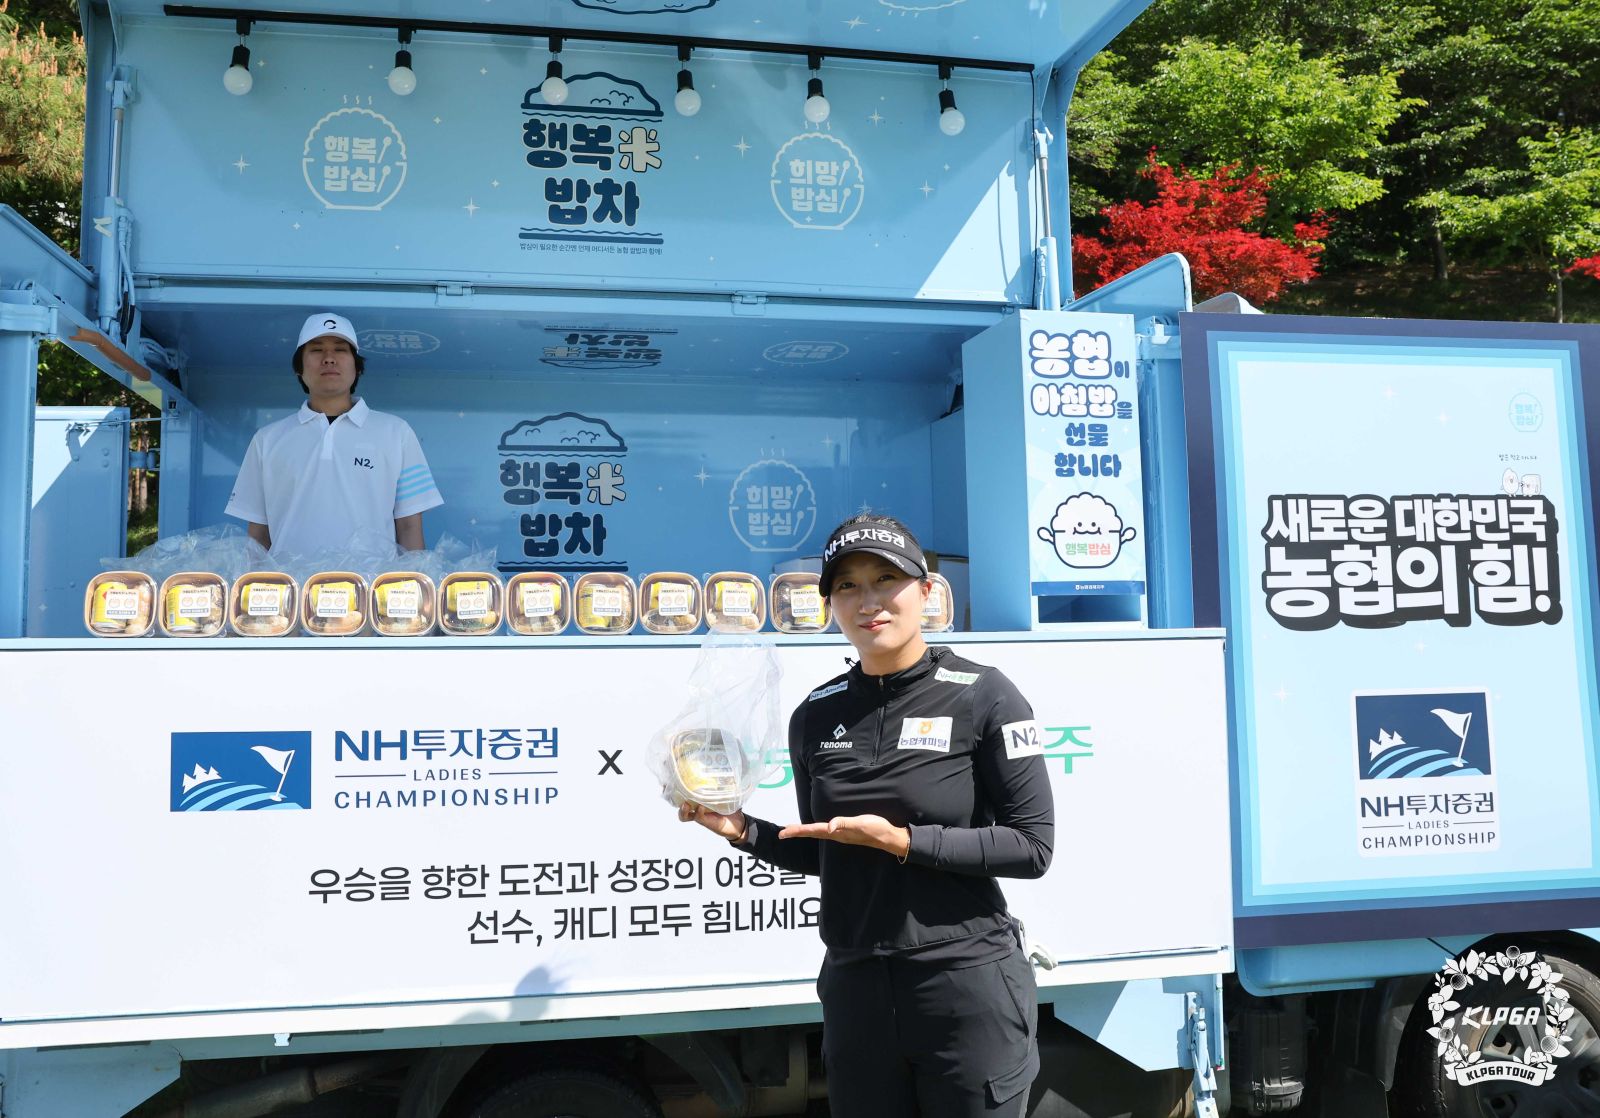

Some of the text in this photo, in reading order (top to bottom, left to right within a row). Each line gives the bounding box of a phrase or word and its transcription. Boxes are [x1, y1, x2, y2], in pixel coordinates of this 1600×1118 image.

[324, 135, 376, 163] 행복
[324, 165, 376, 192] 밥심
[789, 159, 839, 186] 희망
[544, 177, 640, 227] 밥차
[791, 187, 838, 213] 밥심
[1029, 329, 1130, 379] 농협이
[1031, 383, 1133, 420] 아침밥을
[1065, 422, 1109, 447] 선물
[1055, 452, 1122, 478] 합니다
[746, 485, 793, 510] 희망
[748, 512, 793, 536] 밥심
[1265, 496, 1548, 544] 새로운 대한민국
[520, 511, 607, 557] 밥차
[824, 528, 905, 562] NH투자증권
[1065, 543, 1111, 556] 행복밥심
[1265, 543, 1552, 619] 농협의 힘!
[334, 726, 559, 761] NH투자증권
[820, 740, 853, 749] renoma
[413, 768, 482, 782] LADIES
[333, 786, 559, 810] CHAMPIONSHIP
[1360, 792, 1495, 818] NH투자증권
[1408, 820, 1450, 830] LADIES
[1362, 831, 1496, 850] CHAMPIONSHIP
[308, 866, 411, 904] 우승을
[422, 862, 490, 900] 향한
[499, 860, 599, 897] 도전과
[607, 856, 703, 893] 성장의
[467, 897, 821, 947] 선수, 캐디 모두 힘내세요
